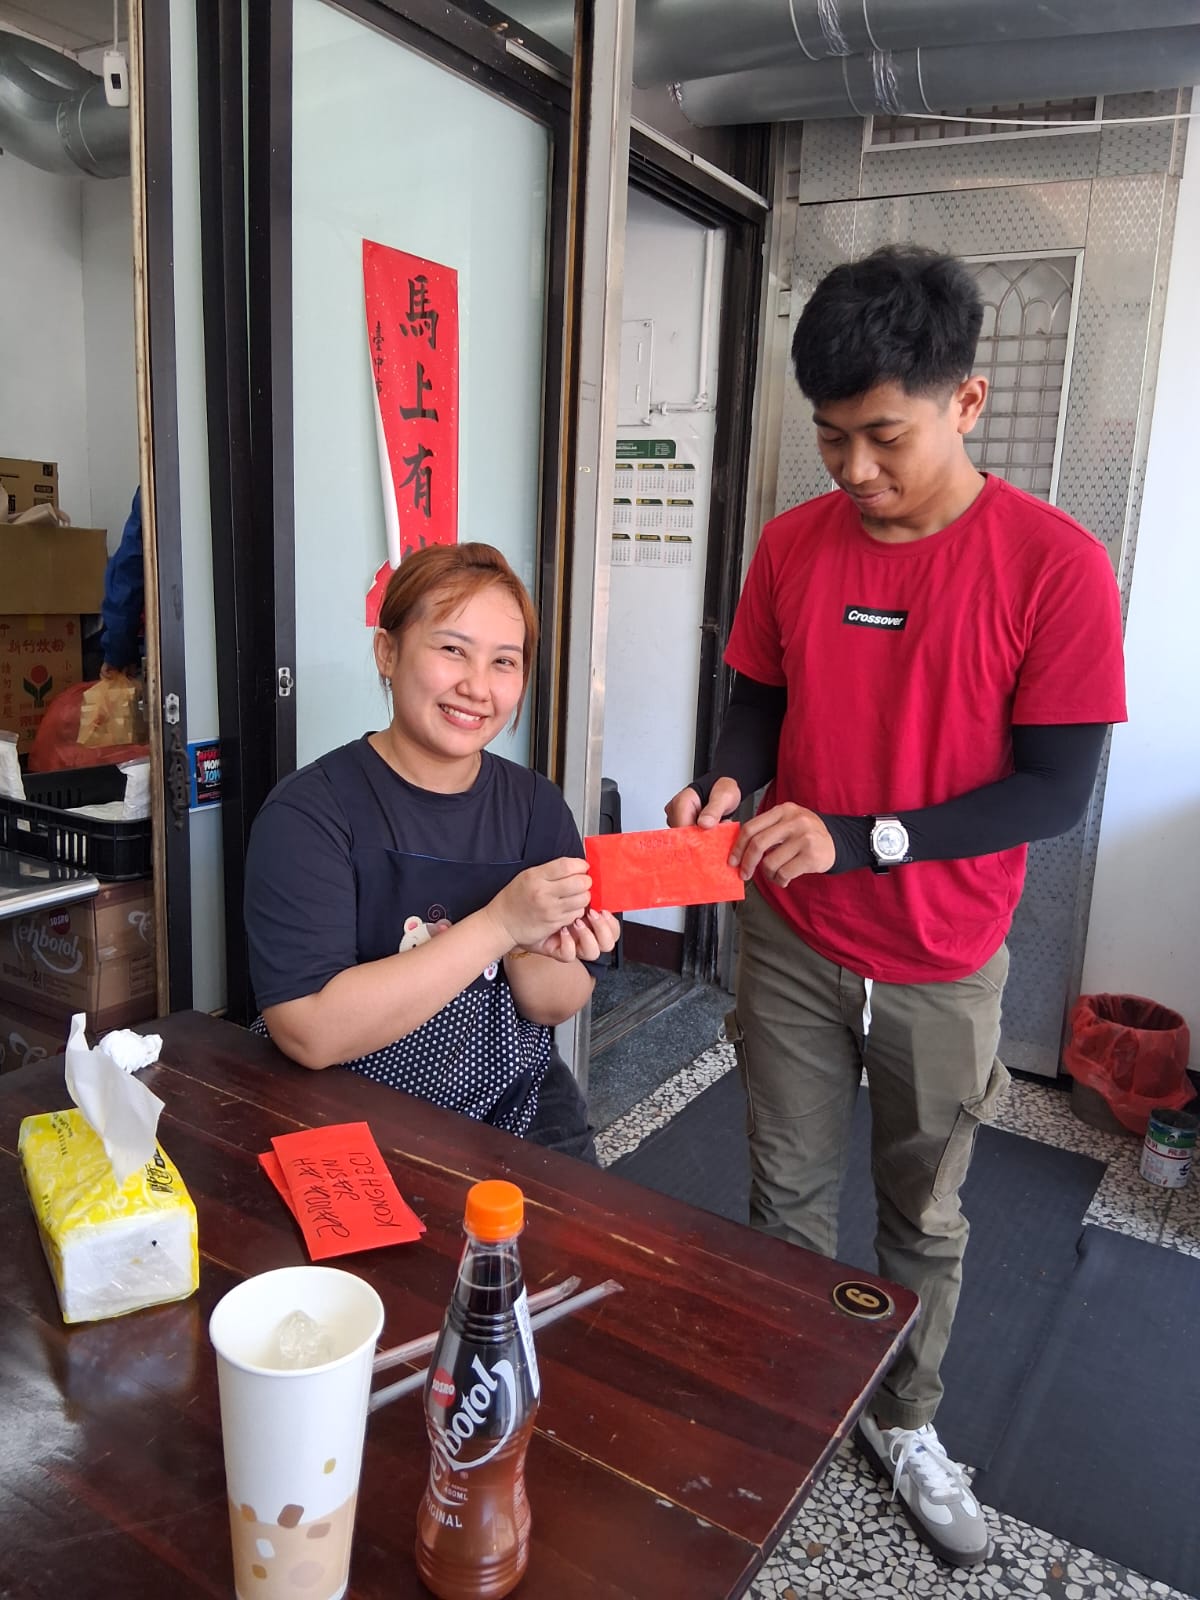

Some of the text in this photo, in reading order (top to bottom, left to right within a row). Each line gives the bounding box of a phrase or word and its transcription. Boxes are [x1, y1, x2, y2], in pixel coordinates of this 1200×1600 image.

[399, 274, 440, 558] 馬上有
[847, 609, 904, 627] Crossover
[427, 1353, 517, 1486] ehbotol
